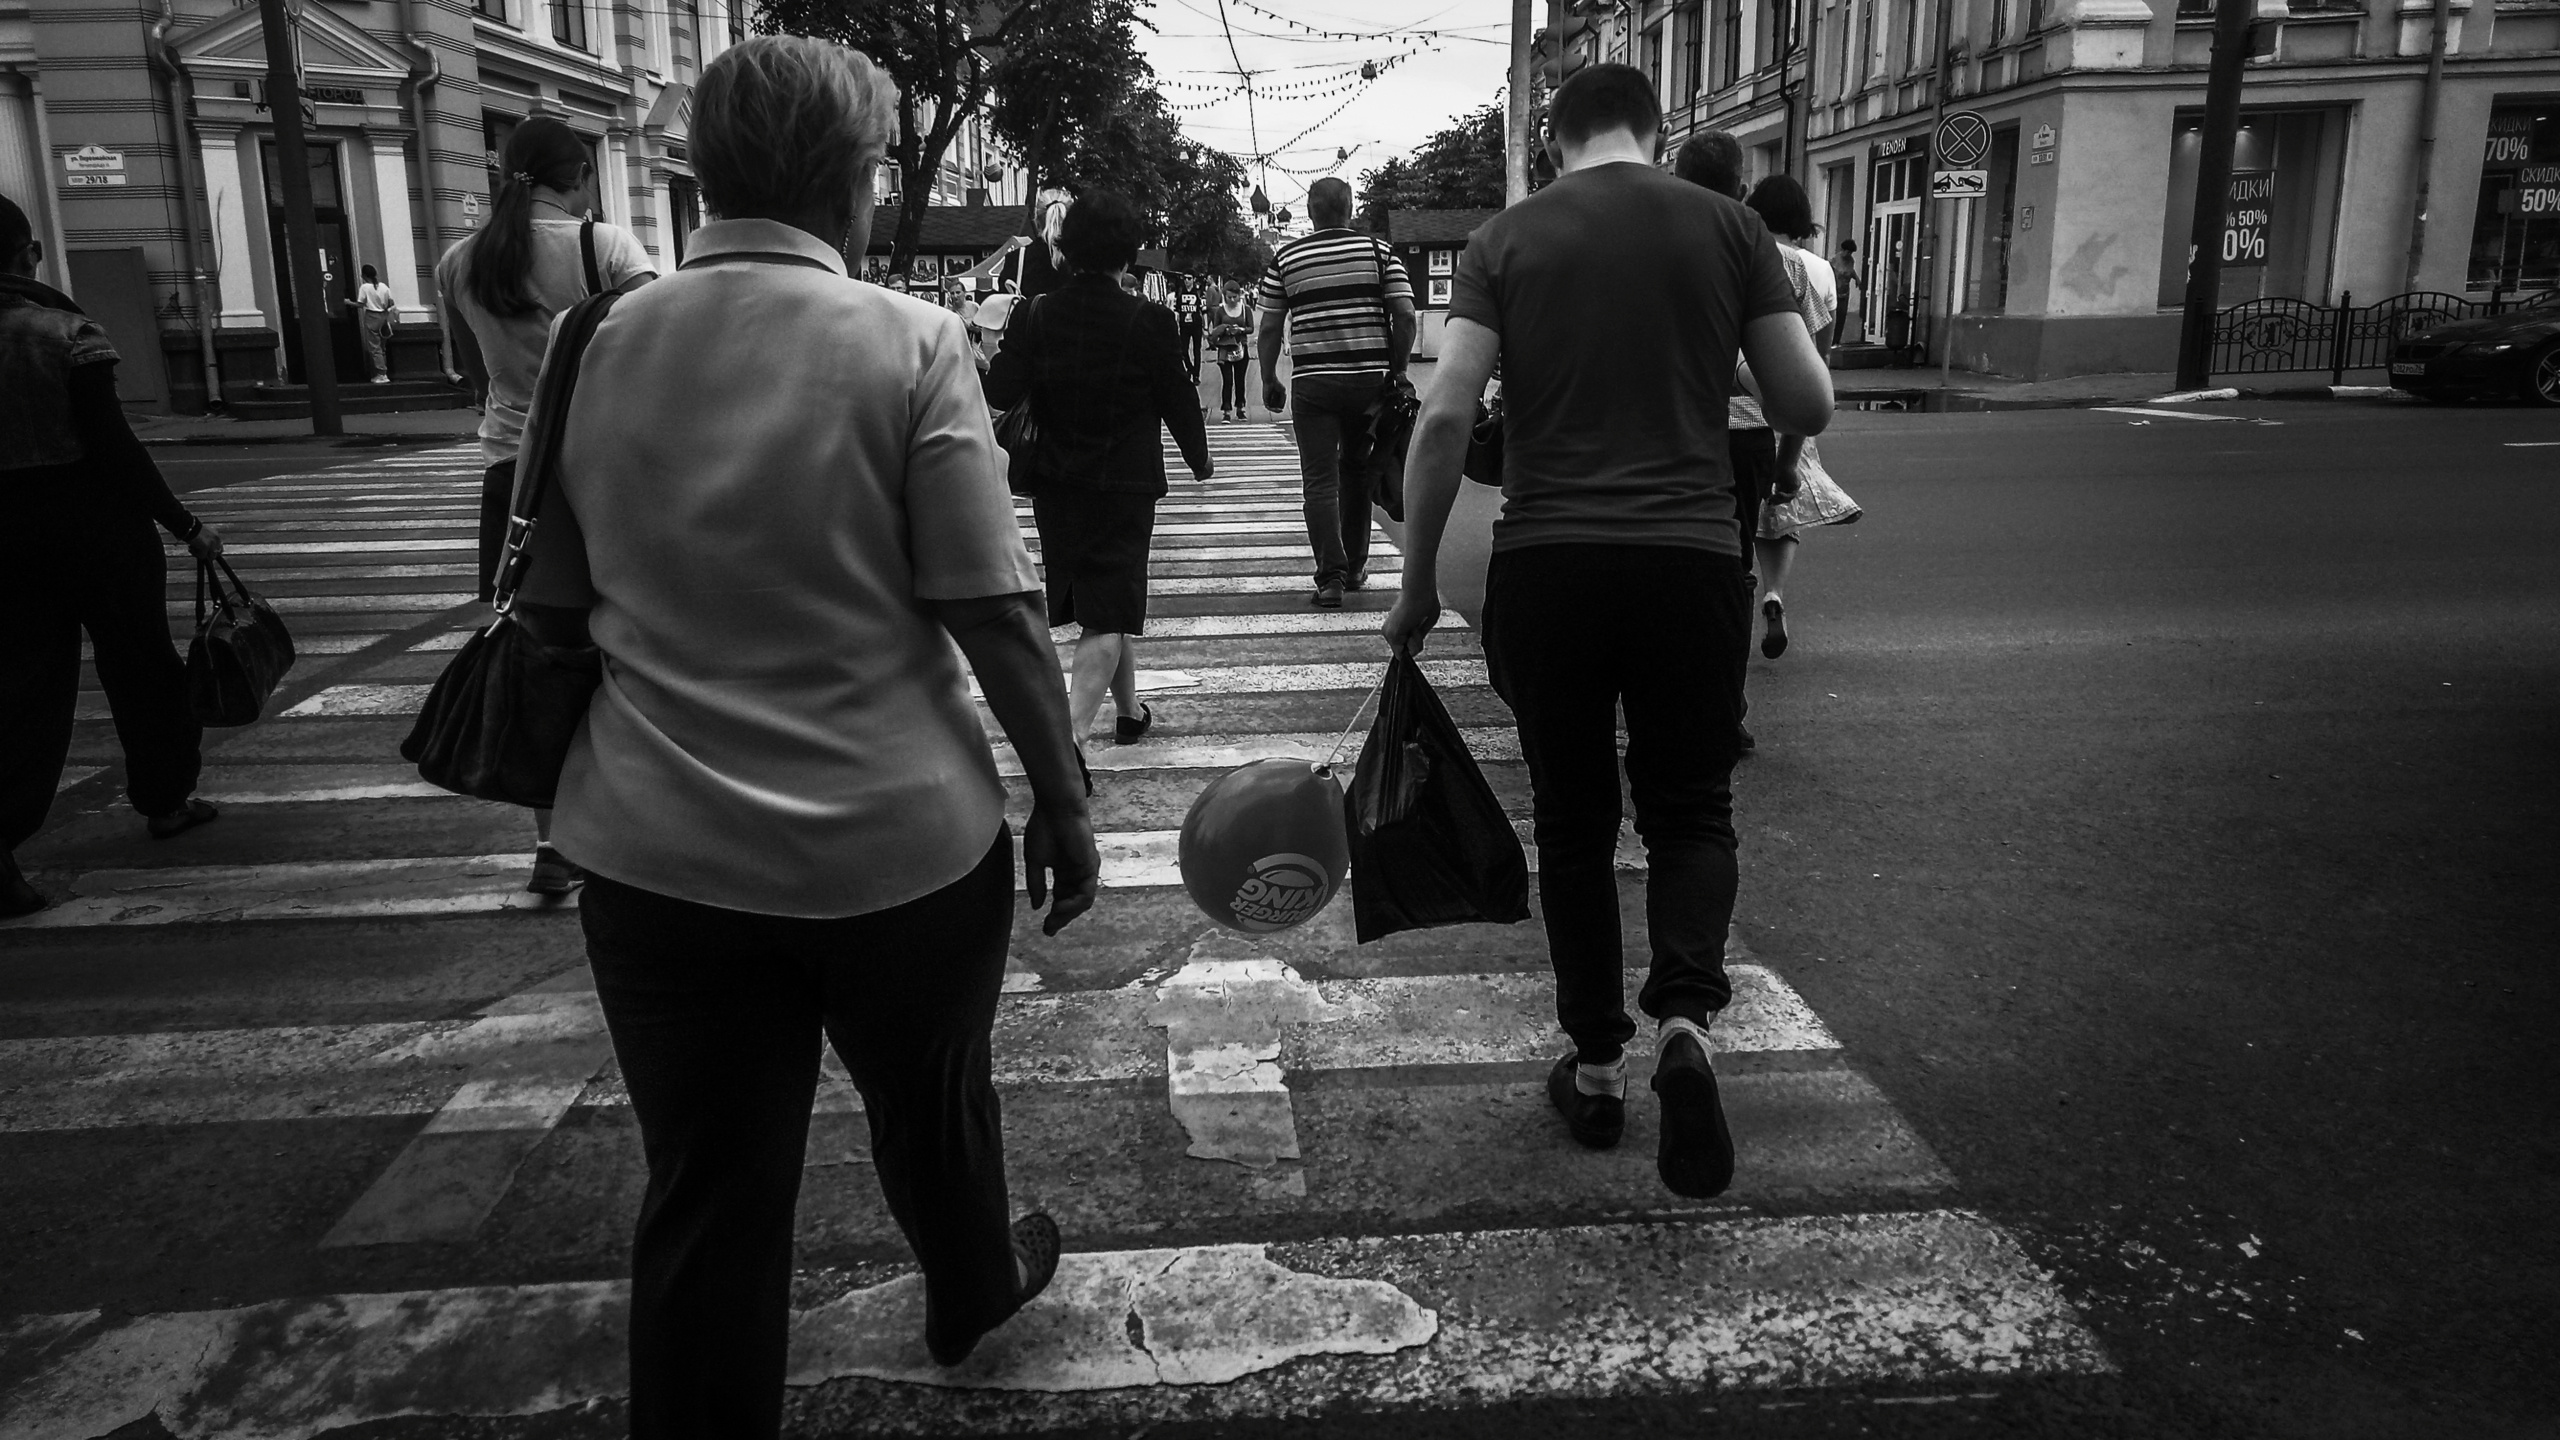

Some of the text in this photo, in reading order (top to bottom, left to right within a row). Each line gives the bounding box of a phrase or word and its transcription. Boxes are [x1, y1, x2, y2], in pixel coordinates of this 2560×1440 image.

[1881, 137, 1907, 156] ZENDEN
[2486, 136, 2529, 161] 70%
[85, 175, 109, 184] 29/18
[2238, 209, 2268, 226] 50%
[1237, 878, 1325, 910] KING
[1229, 896, 1314, 922] BURGER
